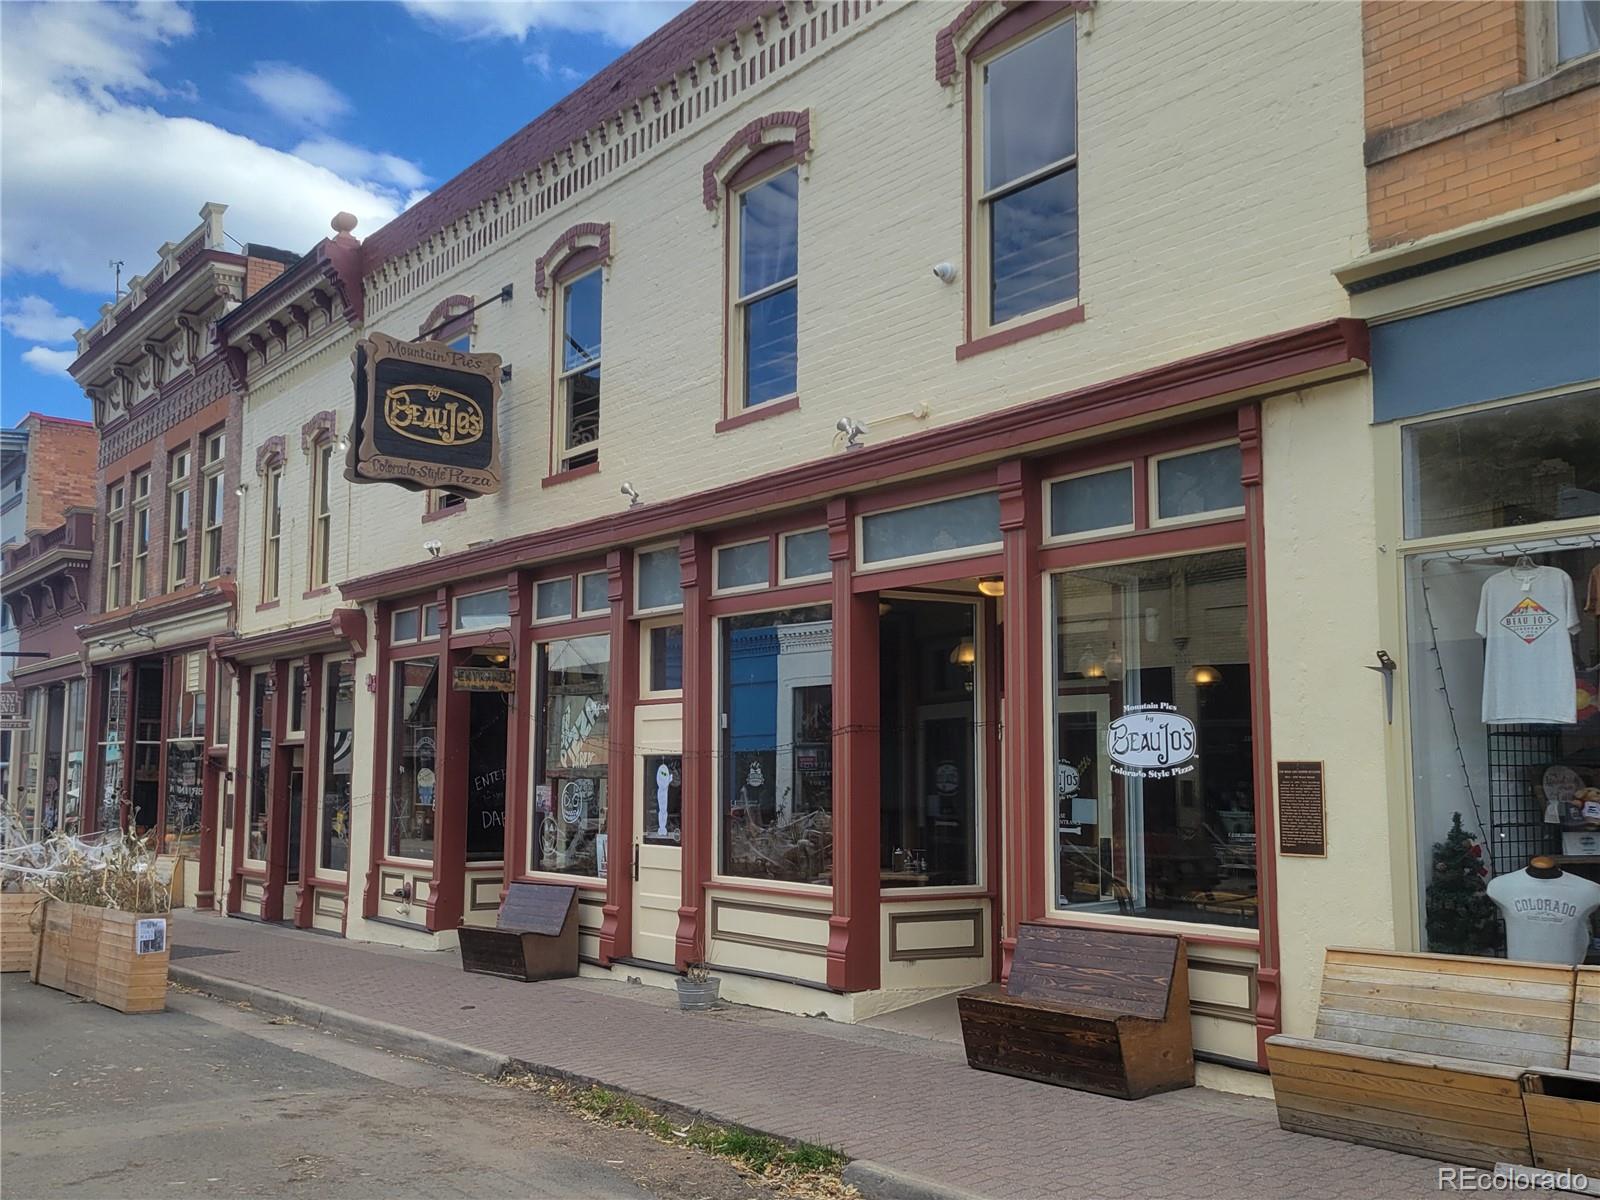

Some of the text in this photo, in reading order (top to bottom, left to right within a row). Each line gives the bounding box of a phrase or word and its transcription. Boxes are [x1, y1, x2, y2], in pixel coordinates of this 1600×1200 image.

[386, 341, 483, 369] Mountain Pies
[427, 386, 440, 401] by
[446, 468, 492, 486] Pizza
[1506, 616, 1528, 626] BEAU
[1123, 702, 1178, 713] Mountain Pies
[1145, 715, 1154, 723] by
[1109, 764, 1195, 779] Colorado Style Pizza
[1515, 898, 1577, 917] COLORADO
